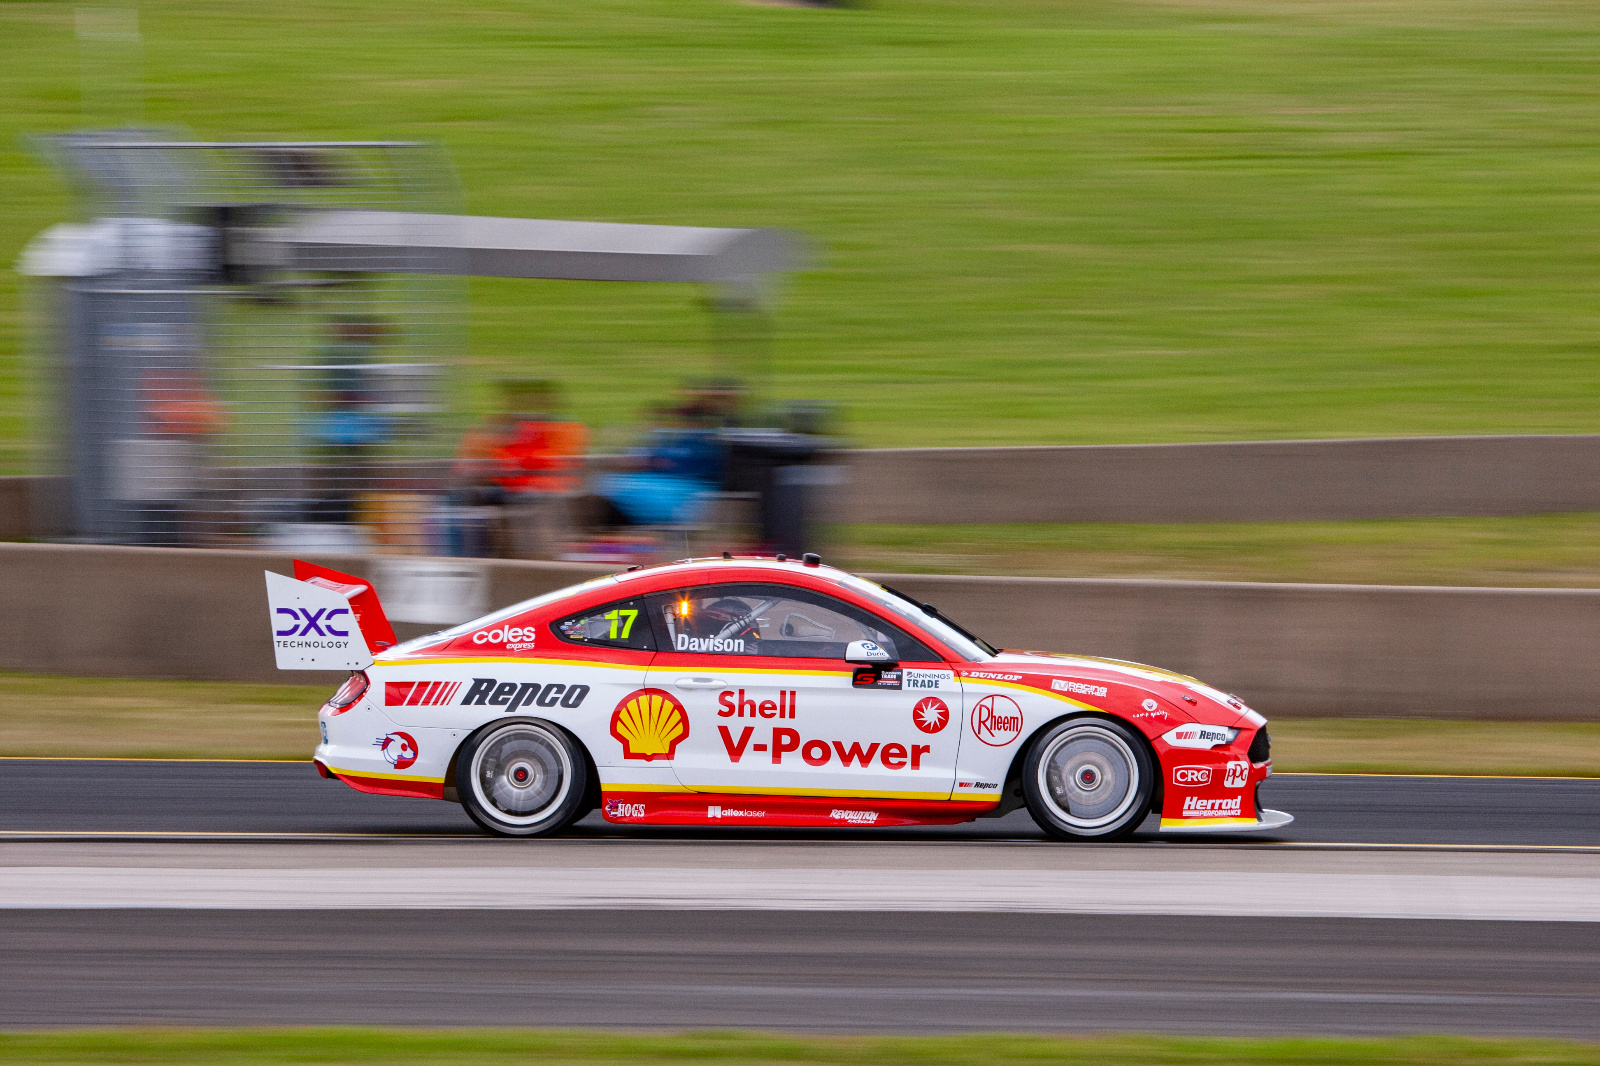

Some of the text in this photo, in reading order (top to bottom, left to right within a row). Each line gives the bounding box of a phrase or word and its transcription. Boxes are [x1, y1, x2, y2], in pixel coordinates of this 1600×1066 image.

[276, 608, 349, 637] DXC
[604, 609, 638, 639] 17
[472, 624, 536, 645] coles
[276, 640, 349, 649] TECHNOLOGY
[506, 642, 535, 652] express
[677, 633, 745, 653] Davison
[907, 671, 951, 680] BUNNINGS
[969, 671, 1023, 682] DUNLOP
[907, 679, 940, 689] TRADE
[1068, 682, 1108, 694] RACING
[460, 677, 591, 713] Repco
[1068, 688, 1107, 698] TOGETHER
[717, 689, 796, 719] Shell
[977, 696, 1020, 738] Rheem
[1199, 730, 1226, 742] Repco
[717, 725, 931, 771] V-Power
[1176, 769, 1209, 782] CRC
[974, 781, 999, 790] Repco
[1183, 796, 1242, 810] Herrod
[617, 803, 646, 818] HOGS
[829, 809, 879, 821] REVOLUTION
